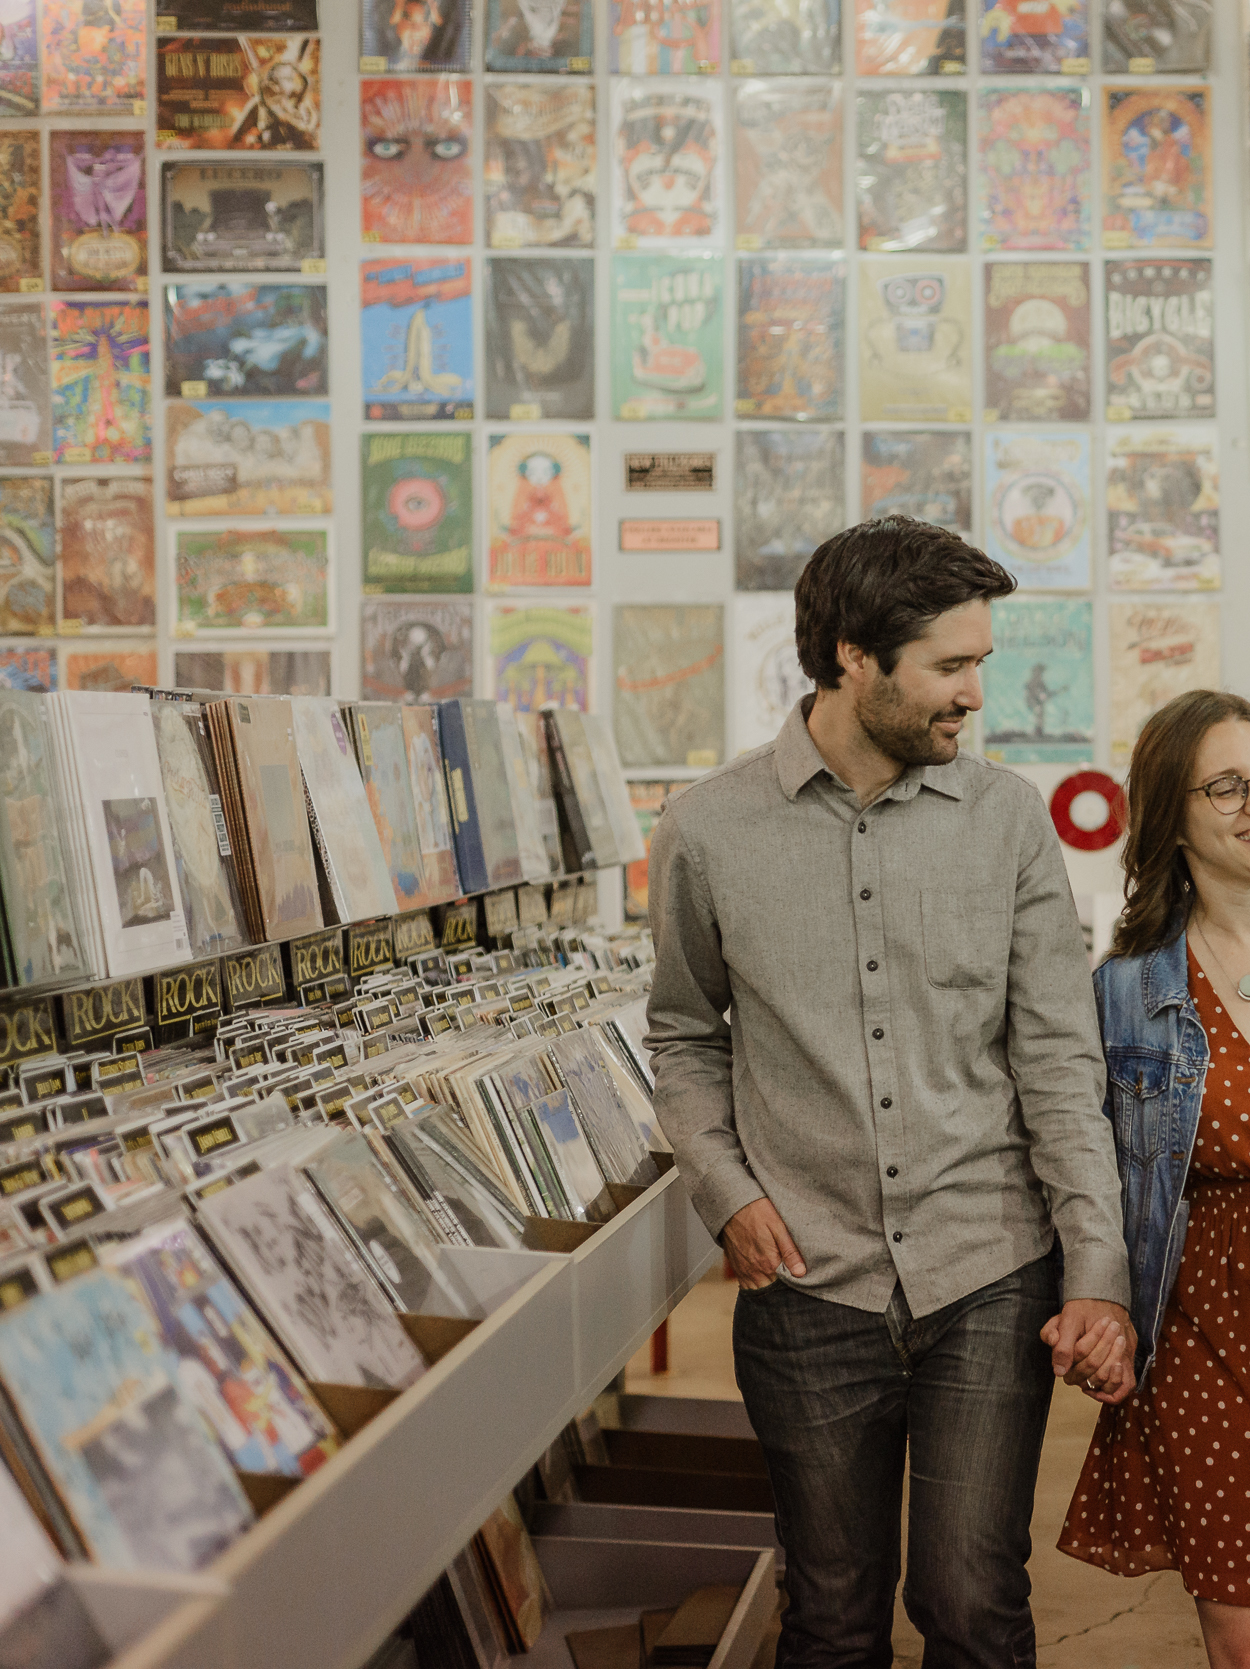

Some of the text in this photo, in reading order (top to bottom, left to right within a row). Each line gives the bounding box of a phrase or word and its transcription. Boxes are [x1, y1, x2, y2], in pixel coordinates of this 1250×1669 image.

[1109, 290, 1212, 339] BICYCLE
[228, 949, 280, 994] ROCK
[297, 941, 340, 982] ROCK
[353, 933, 391, 968] ROCK
[70, 979, 140, 1034] ROCK
[161, 965, 218, 1016] ROCK
